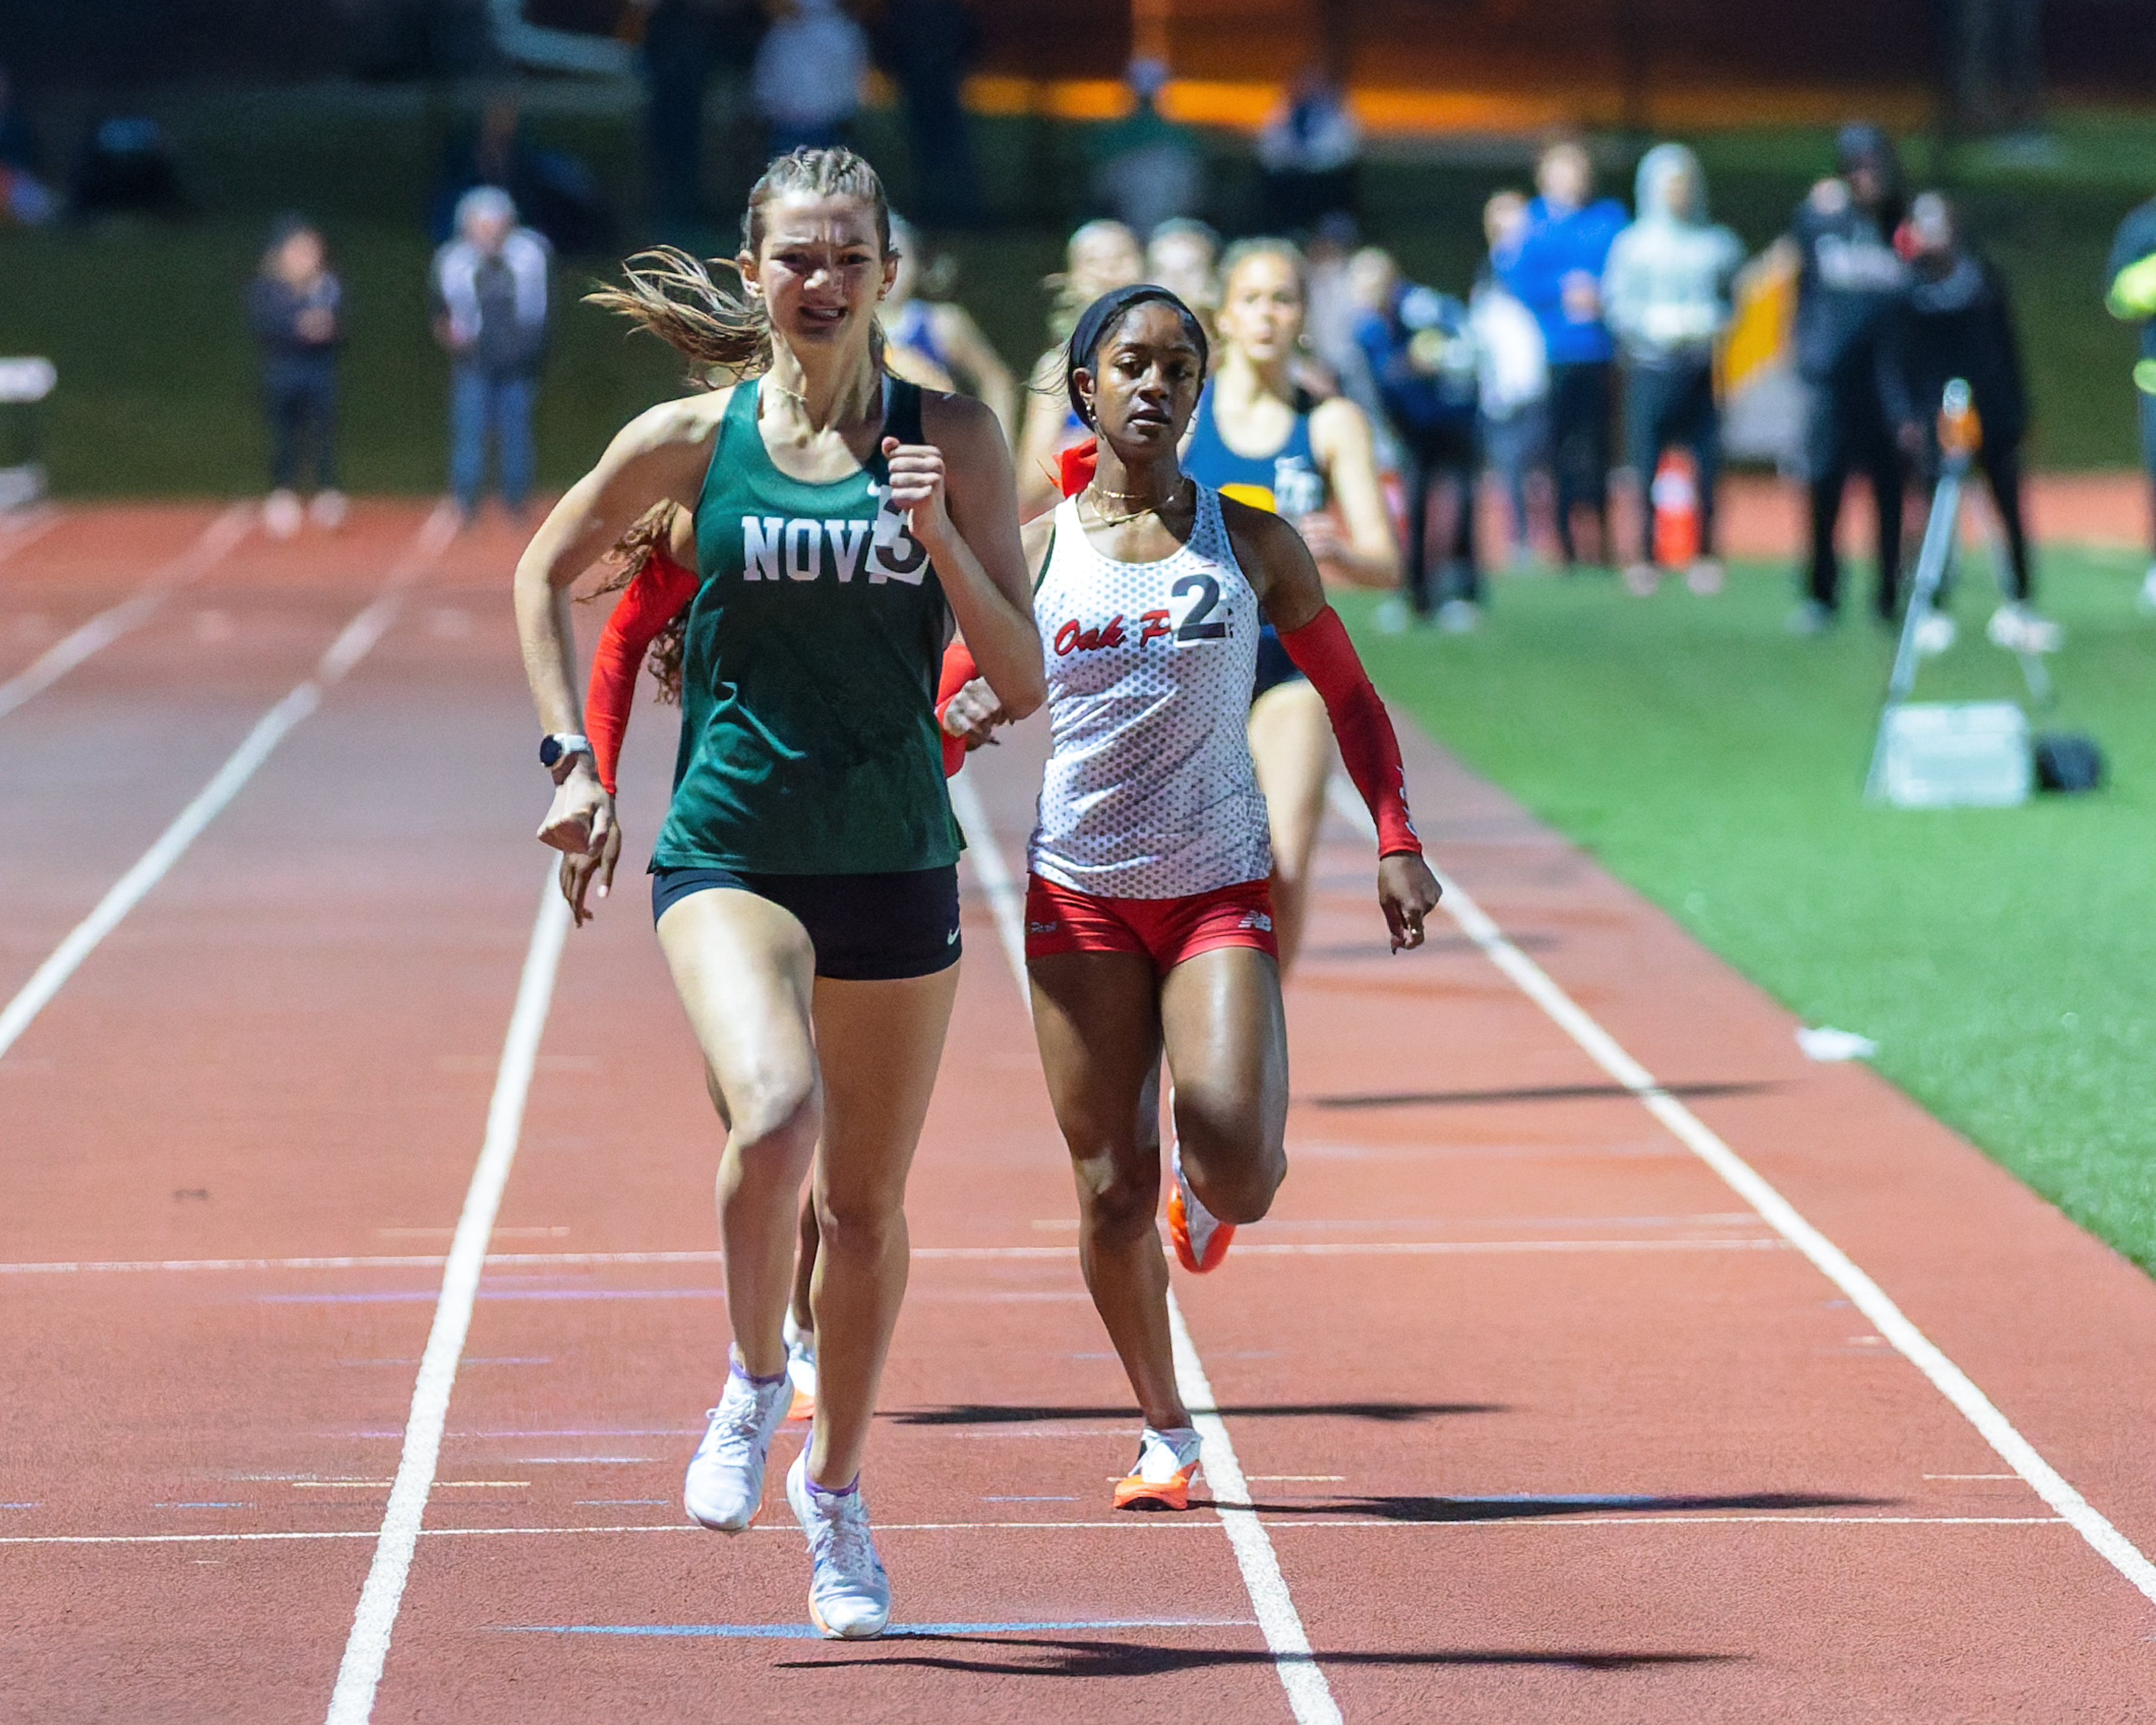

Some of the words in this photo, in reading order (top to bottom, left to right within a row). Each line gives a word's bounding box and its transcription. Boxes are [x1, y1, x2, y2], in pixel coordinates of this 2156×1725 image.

[741, 515, 889, 584] NOV
[1054, 615, 1127, 656] Oak
[1171, 573, 1226, 641] 2
